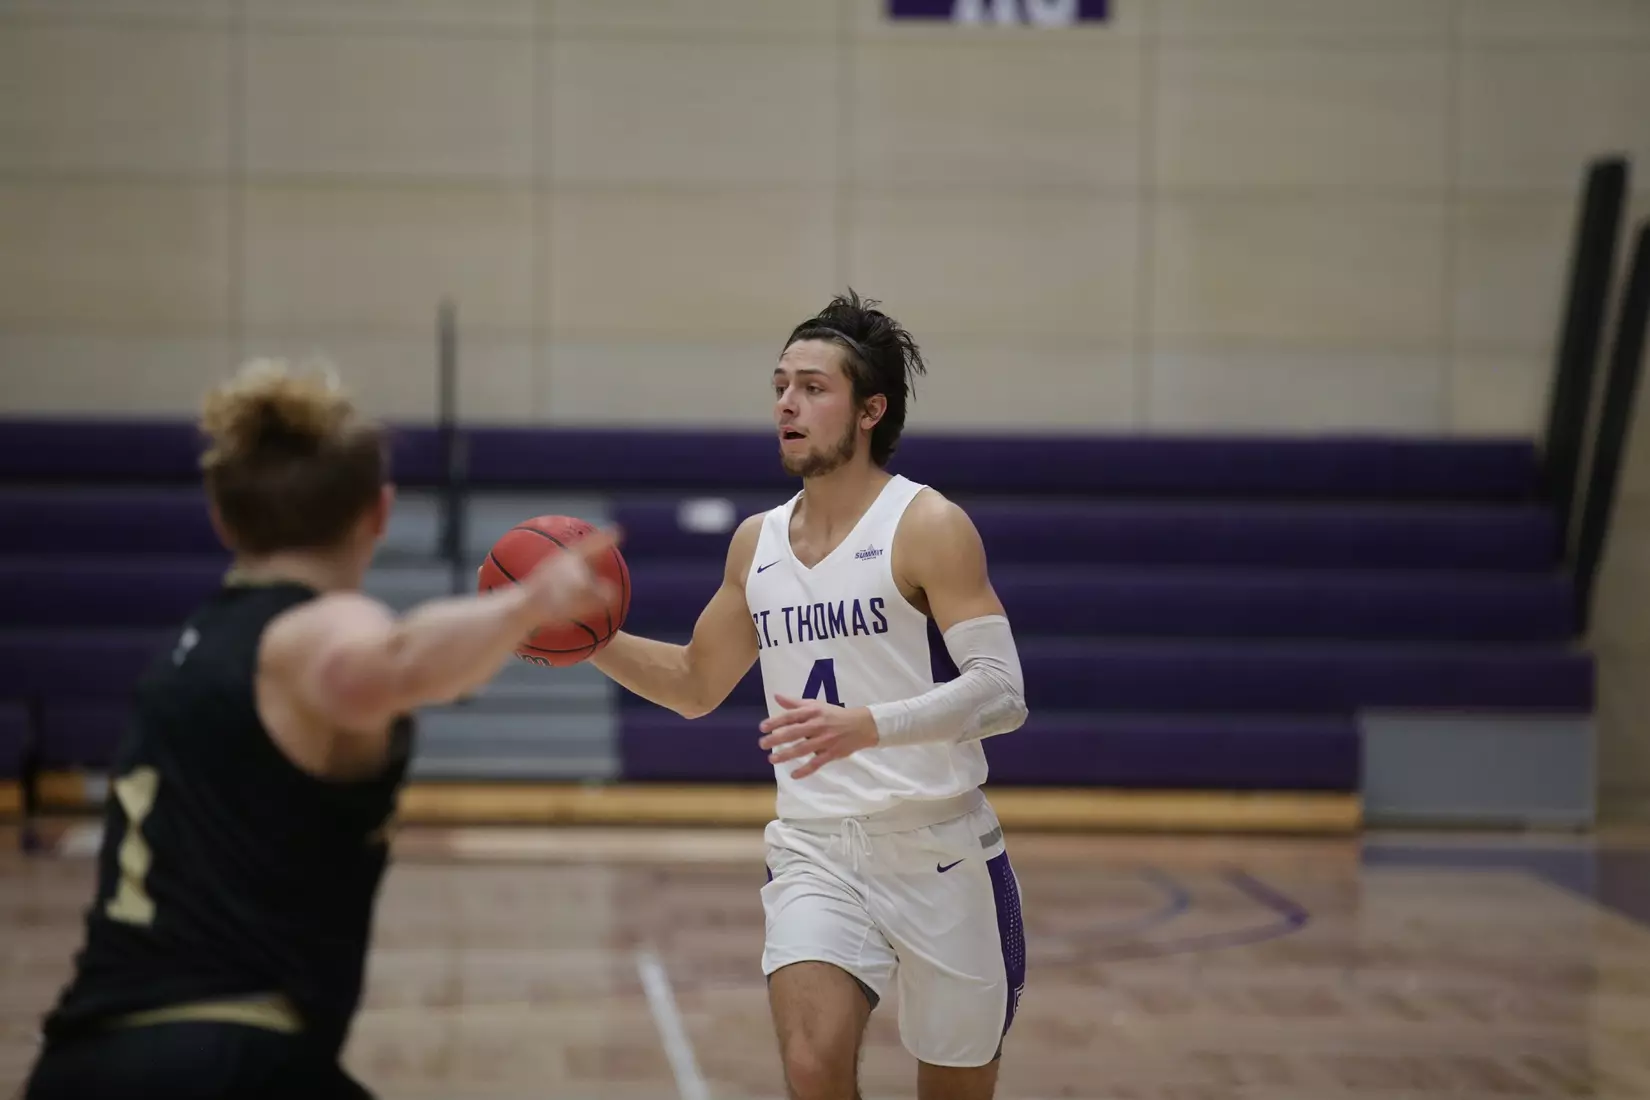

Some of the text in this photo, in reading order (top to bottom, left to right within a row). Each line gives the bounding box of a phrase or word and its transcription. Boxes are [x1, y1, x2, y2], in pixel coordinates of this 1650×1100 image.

[855, 549, 883, 559] SUMMIT
[781, 597, 888, 643] THOMAS
[802, 658, 845, 708] 4
